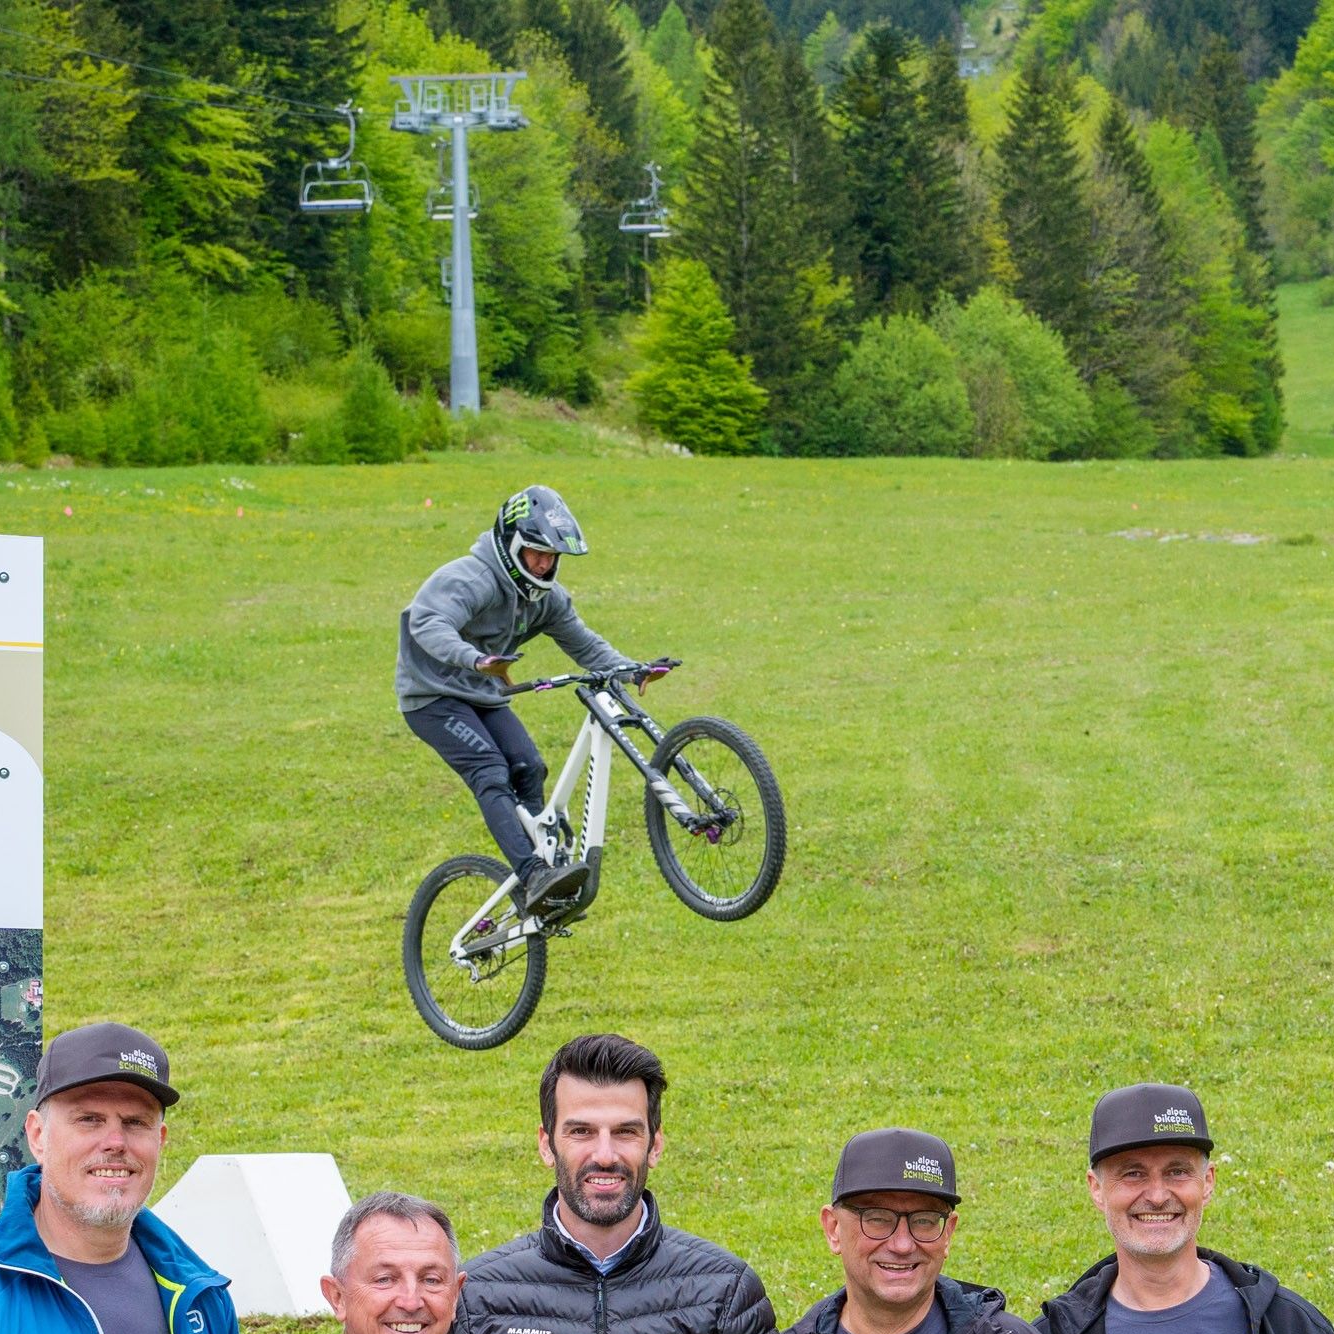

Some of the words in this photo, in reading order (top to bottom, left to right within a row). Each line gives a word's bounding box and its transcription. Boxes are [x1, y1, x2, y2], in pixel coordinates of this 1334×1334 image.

[444, 716, 491, 753] LEATT
[1167, 1107, 1187, 1117] alpen
[1154, 1114, 1193, 1125] bikepark
[918, 1156, 939, 1167] alpen
[905, 1160, 942, 1176] bikepark
